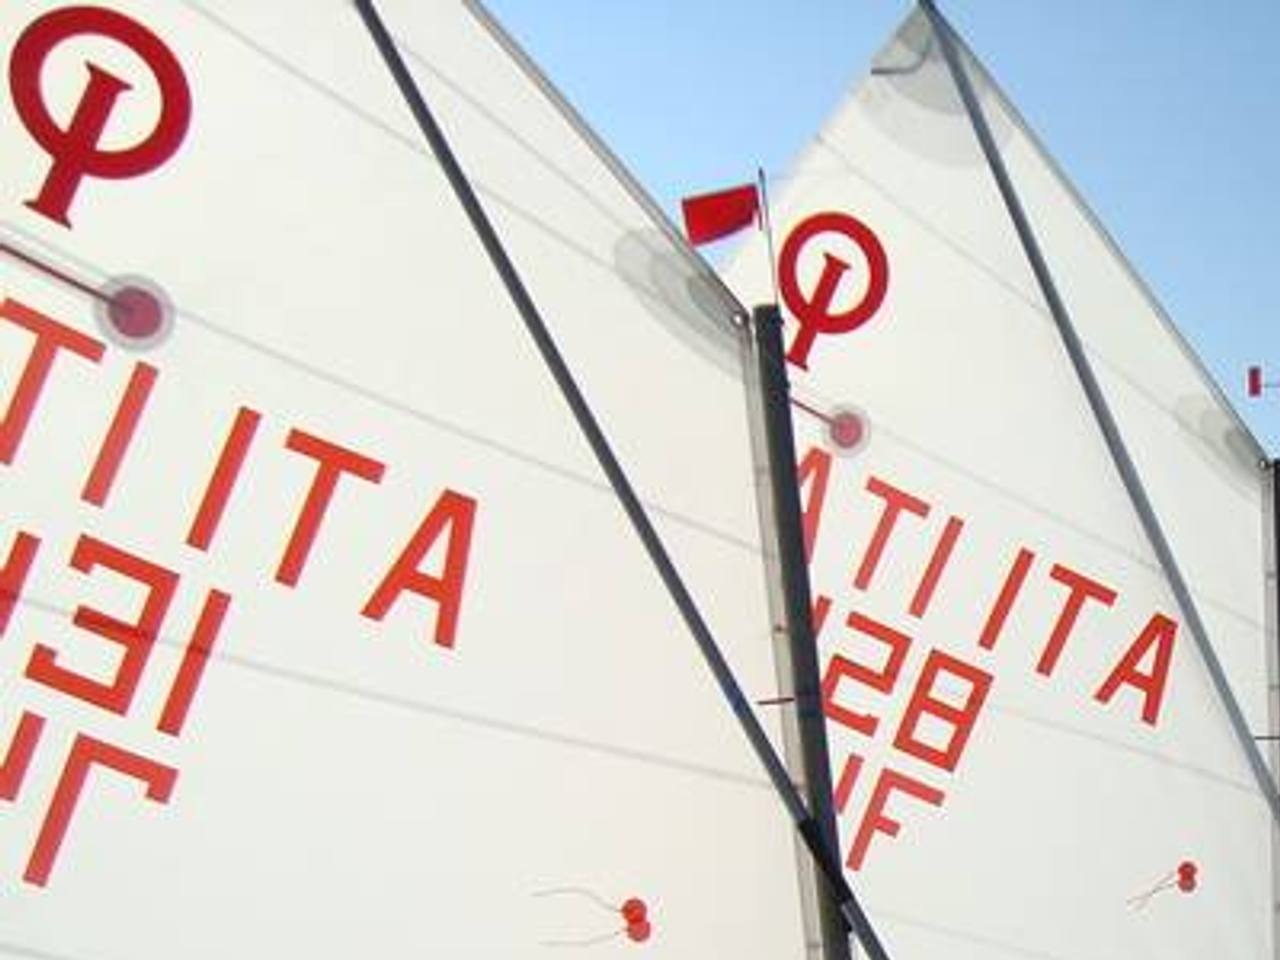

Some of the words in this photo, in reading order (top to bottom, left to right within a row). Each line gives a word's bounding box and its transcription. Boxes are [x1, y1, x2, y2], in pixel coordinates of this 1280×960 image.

[187, 407, 478, 650] ITA
[806, 596, 993, 773] 28
[979, 546, 1179, 727] ITA
